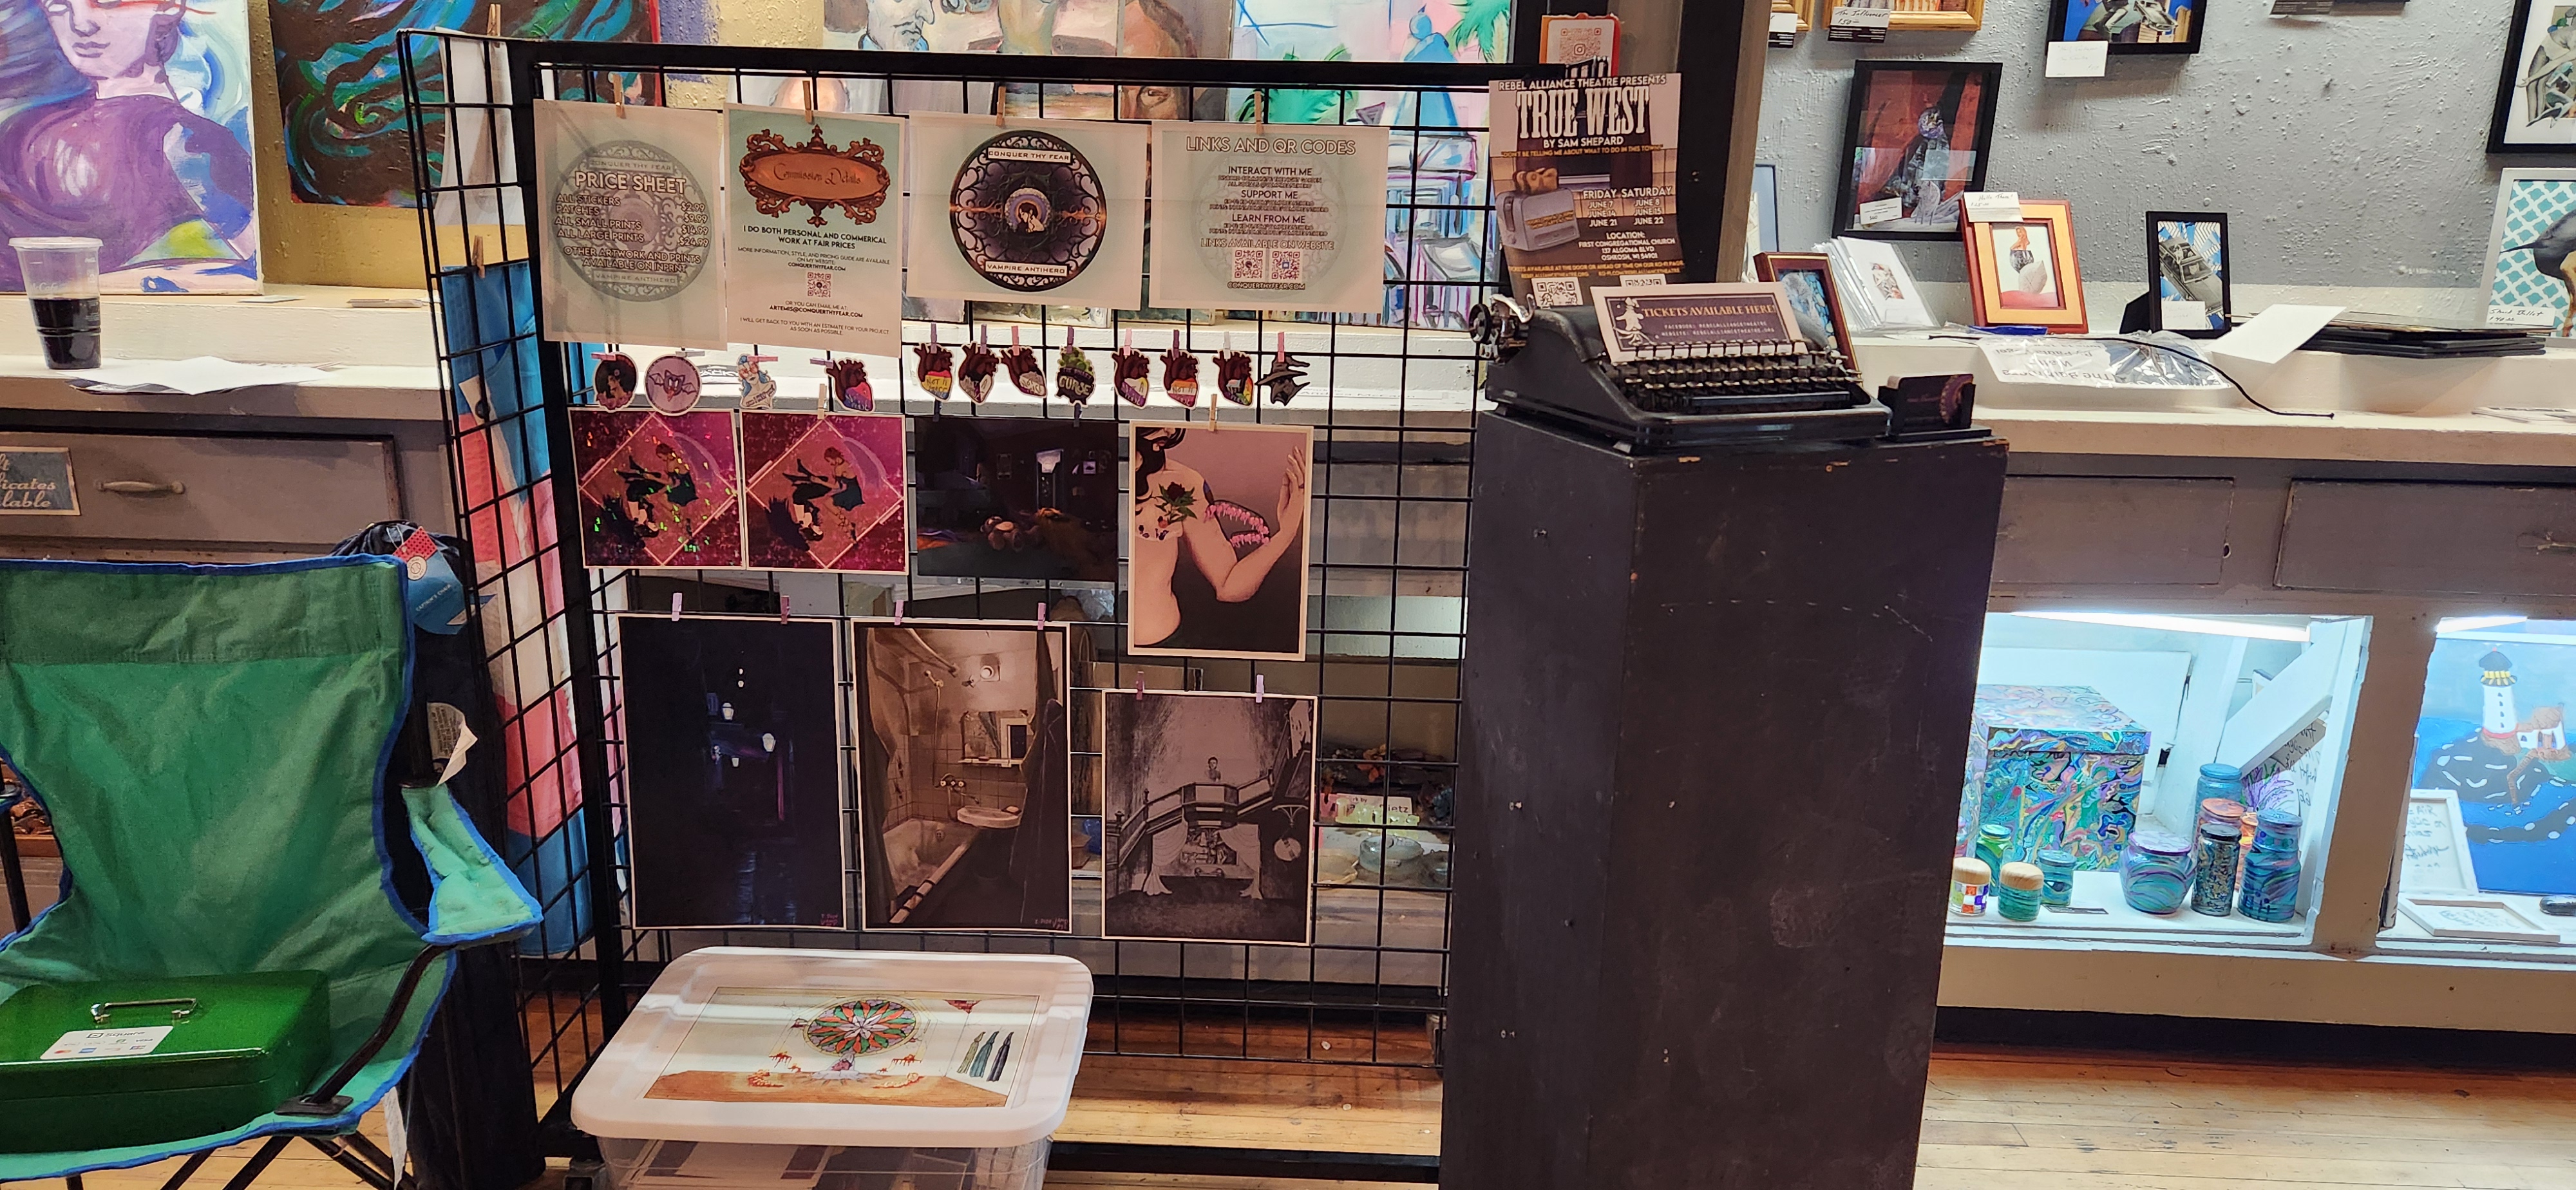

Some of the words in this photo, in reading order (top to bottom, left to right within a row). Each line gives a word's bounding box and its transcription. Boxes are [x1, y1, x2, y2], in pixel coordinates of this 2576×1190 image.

[1498, 80, 1526, 91] REBEL
[1528, 78, 1576, 90] ALLIANCE
[1577, 77, 1618, 88] THEATRE
[1620, 75, 1667, 87] PRESENTS
[1515, 88, 1578, 139] TRUE
[1584, 86, 1650, 137] WEST
[1186, 136, 1231, 152] LINKS
[1234, 137, 1269, 153] AND
[1272, 138, 1297, 154] QR
[1300, 139, 1356, 155] CODES
[1543, 138, 1555, 149] BY
[1557, 137, 1578, 148] SAM
[1580, 136, 1624, 147] SHEPARD
[773, 162, 822, 181] Commission
[825, 167, 861, 185] Details
[1228, 165, 1272, 175] INTERACT
[1274, 167, 1297, 176] WITH
[1298, 167, 1312, 176] ME
[575, 171, 628, 190] PRICE
[632, 175, 687, 194] SHEET
[1241, 189, 1283, 199] SUPPORT
[1285, 191, 1298, 199] ME
[1583, 188, 1617, 200] FRIDAY
[1621, 186, 1672, 198] SATURDAY
[556, 194, 574, 203] ALL
[577, 195, 621, 206] STICKERS
[681, 202, 705, 212] $2.99
[1654, 198, 1660, 206] 8
[555, 204, 600, 216] PATCHES
[683, 213, 707, 223] $9.99
[1232, 213, 1261, 222] LEARN
[1264, 214, 1290, 223] FROM
[1293, 215, 1306, 223] ME
[1634, 208, 1653, 216] JUNE
[554, 216, 573, 226] ALL
[575, 218, 608, 228] SMALL
[609, 219, 642, 231] PRINTS
[681, 225, 709, 236] $14.99
[1589, 219, 1609, 227] JUNE
[1633, 217, 1653, 225] JUNE
[557, 229, 576, 238] ALL
[578, 229, 611, 240] LARGE
[612, 232, 645, 243] PRINTS
[678, 236, 709, 248] $24.99
[783, 229, 822, 238] PERSONAL
[1605, 231, 1646, 240] LOCATION:
[778, 236, 800, 245] WORK
[831, 241, 855, 249] PRICES
[1200, 238, 1227, 247] LINKS
[1228, 238, 1278, 249] AVAILABLE
[1280, 240, 1296, 249] ON
[1296, 240, 1334, 250] WEBSITE
[1595, 239, 1650, 248] CONGREGATIONAL
[564, 245, 597, 257] OTHER
[598, 247, 645, 260] ARTWORK
[647, 250, 668, 261] AND
[670, 252, 701, 265] PRINTS
[582, 258, 635, 270] AVAILABLE
[636, 261, 652, 271] ON
[654, 262, 687, 274] INPRNT
[788, 262, 846, 271] CONQUERTHYFEAR.COM
[1227, 281, 1306, 290] CONQUERTHYFEAR.COM
[1641, 307, 1688, 318] TICKETS
[1689, 305, 1743, 316] AVAILABLE
[1745, 303, 1776, 314] HERE!
[2082, 372, 2113, 381] The
[1059, 376, 1092, 396] CURSE
[437, 583, 451, 596] CHAIR
